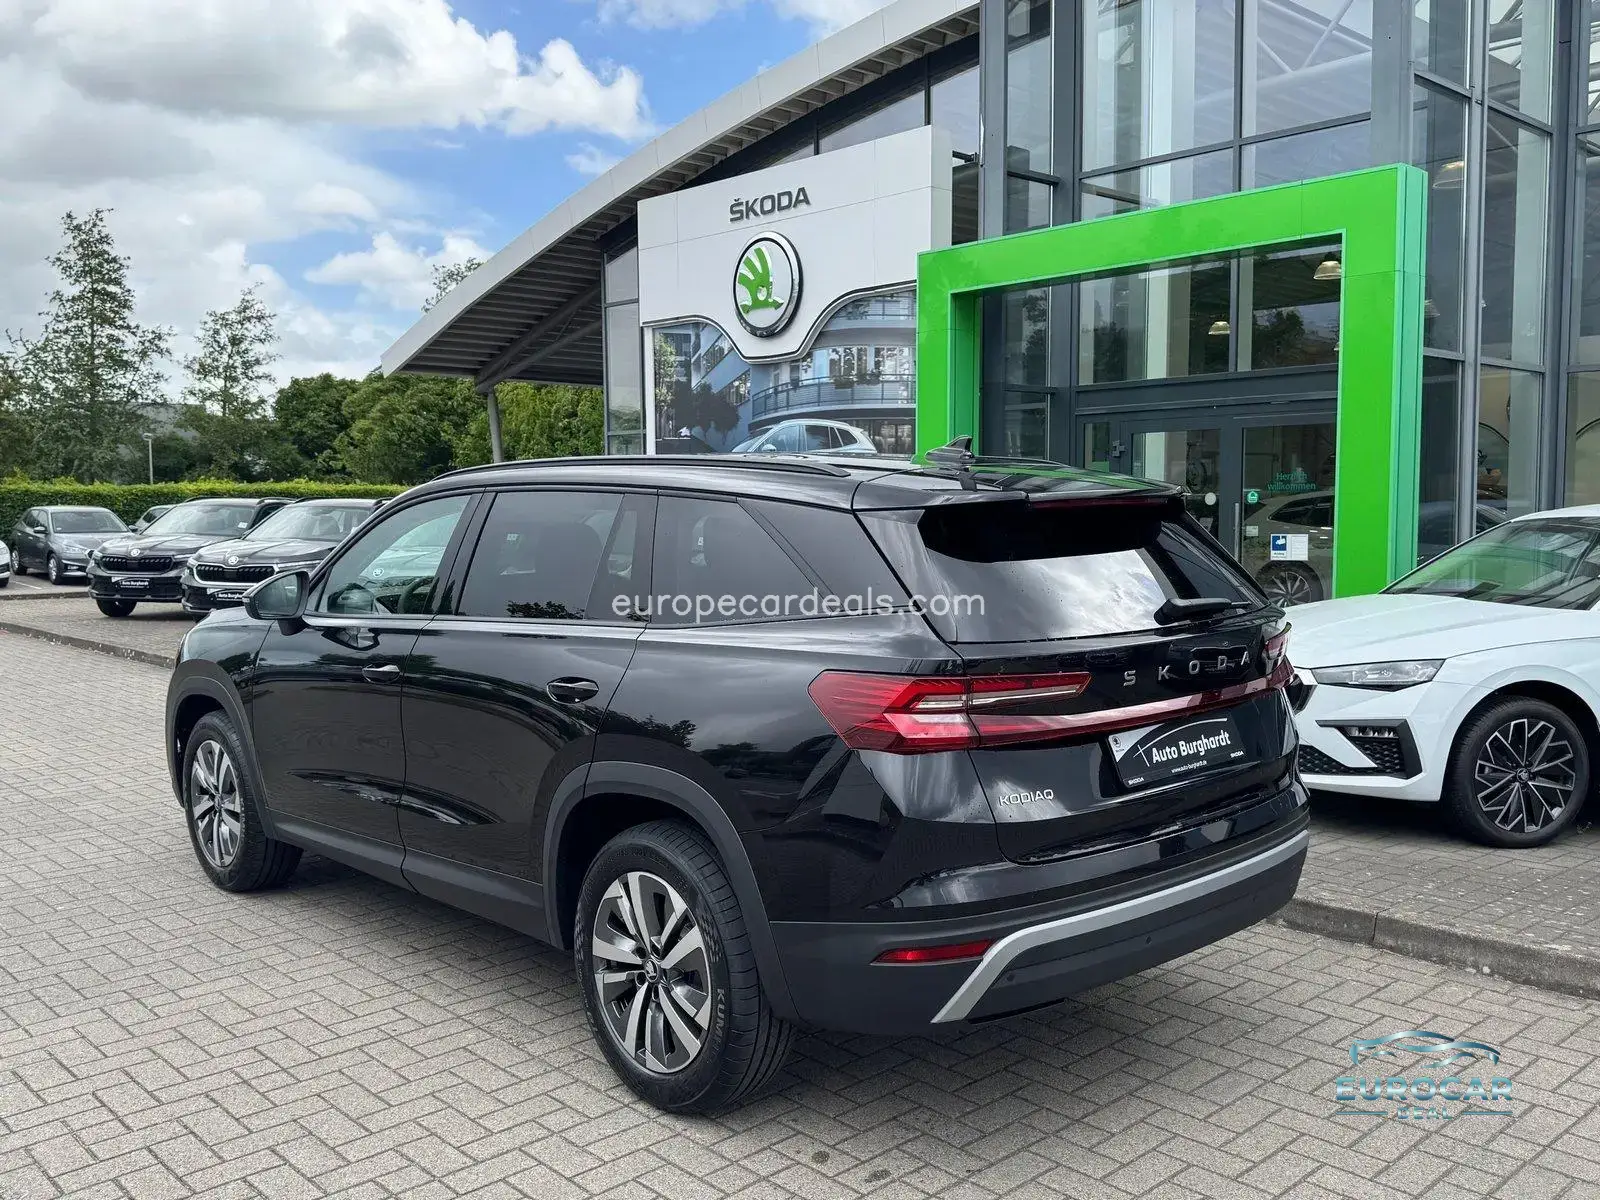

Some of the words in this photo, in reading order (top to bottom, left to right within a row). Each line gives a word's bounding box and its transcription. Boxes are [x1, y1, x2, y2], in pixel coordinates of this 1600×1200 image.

[729, 186, 811, 223] ŠKODA
[1122, 650, 1252, 687] SKODA
[1152, 746, 1179, 764] Auto
[1179, 729, 1231, 757] Burghardt
[999, 788, 1055, 807] KODIAQ
